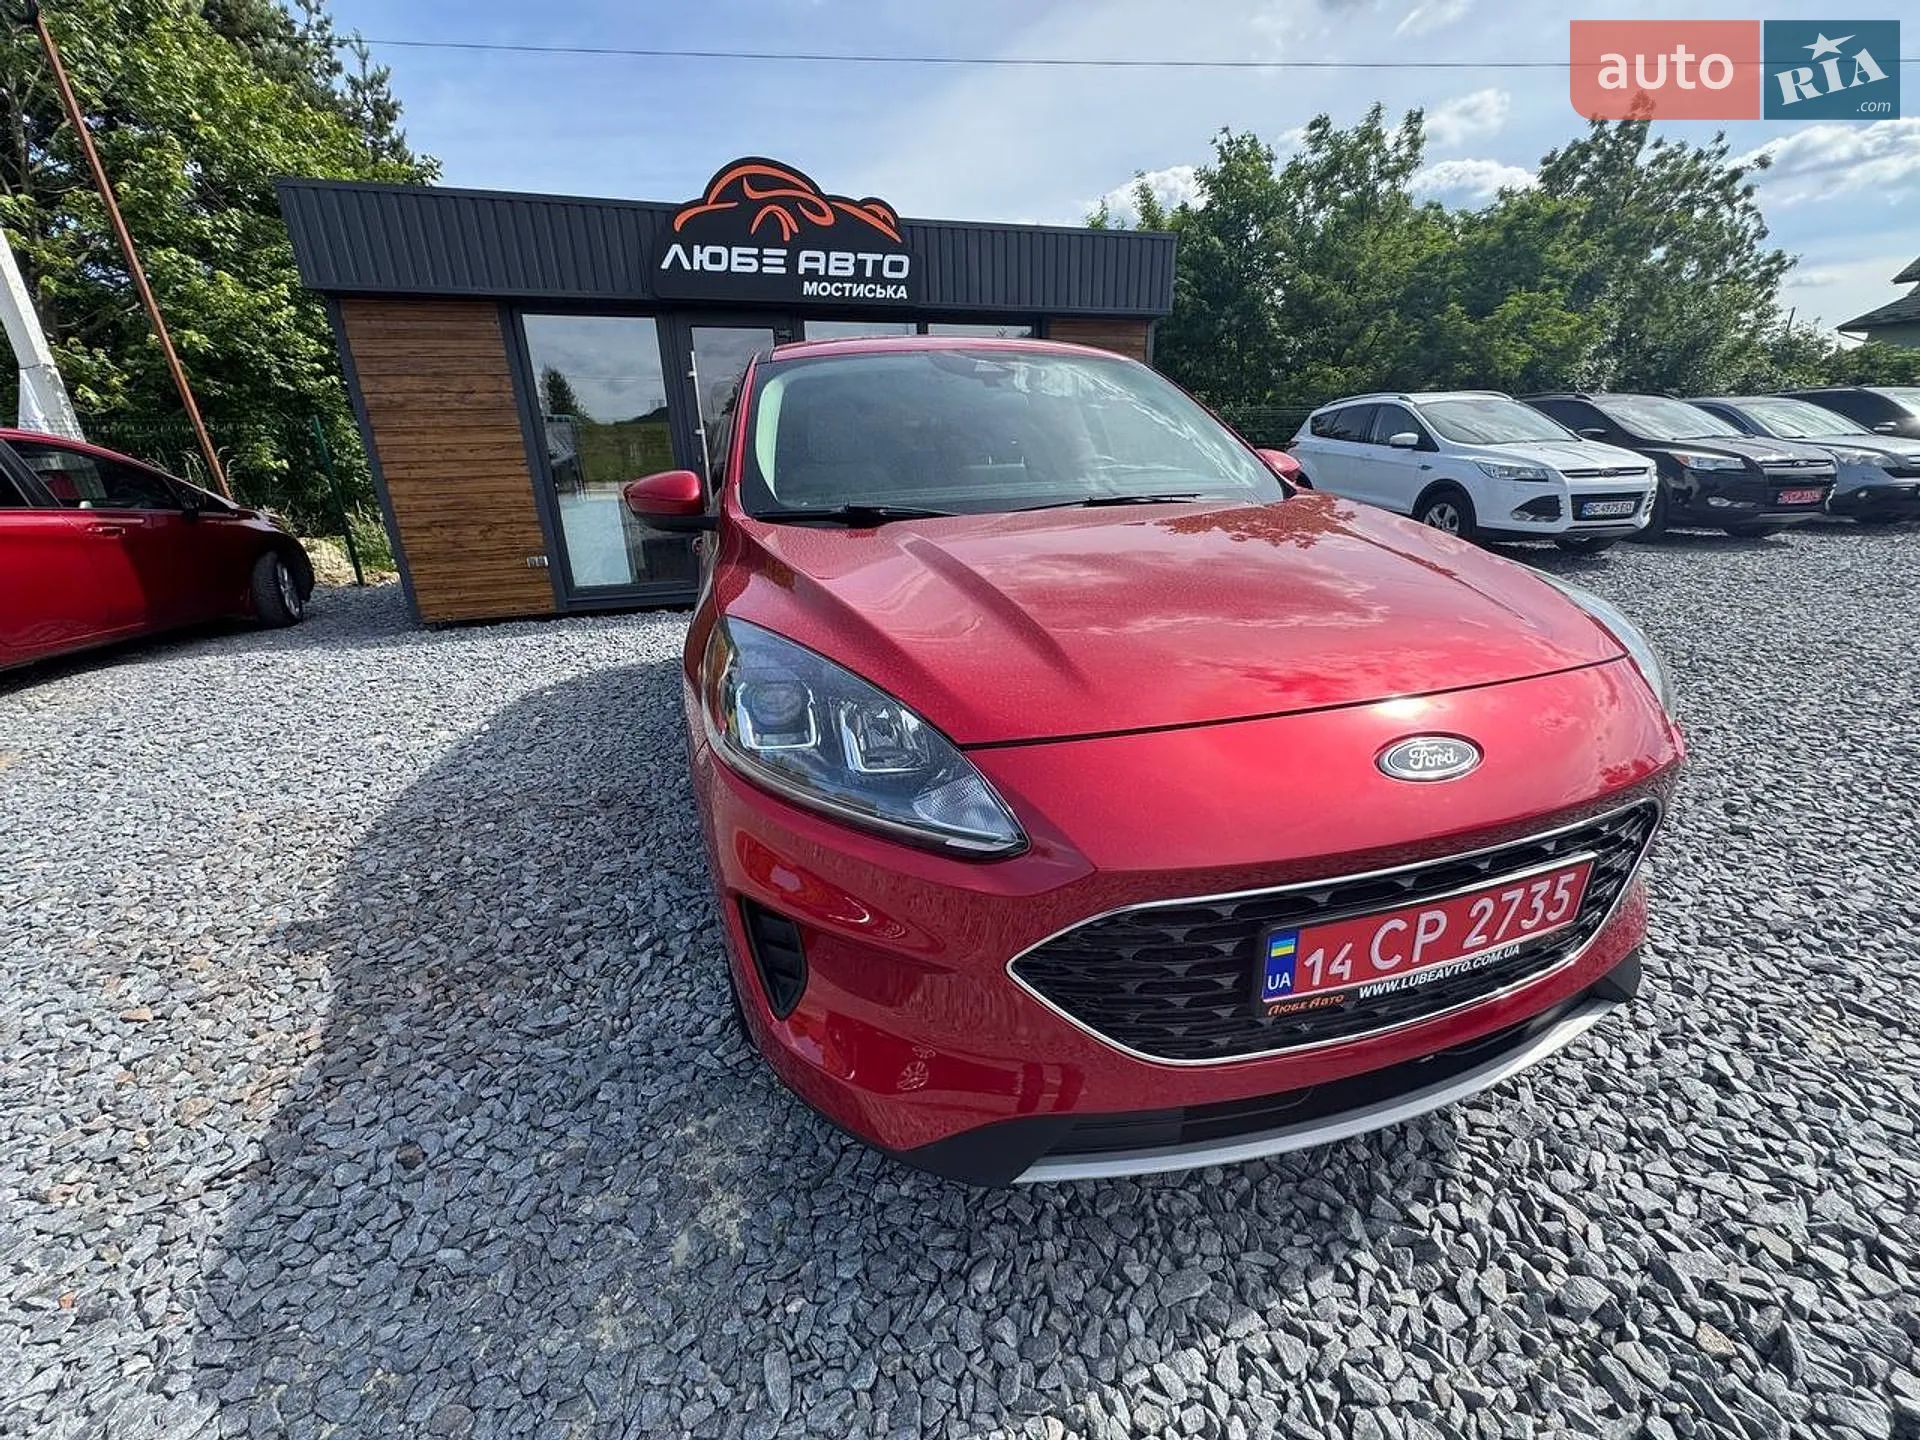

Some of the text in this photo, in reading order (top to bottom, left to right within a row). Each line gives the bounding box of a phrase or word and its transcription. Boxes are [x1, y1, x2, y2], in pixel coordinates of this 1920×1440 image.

[660, 244, 910, 279] ЛЮБЕ АВТО
[803, 281, 908, 299] МОСТИСЬКА
[1408, 745, 1458, 769] Ford
[1303, 873, 1576, 986] 14 CP 2735
[1267, 974, 1291, 991] UA
[1358, 944, 1520, 999] WWW.LUBEAVTO.COM.UA
